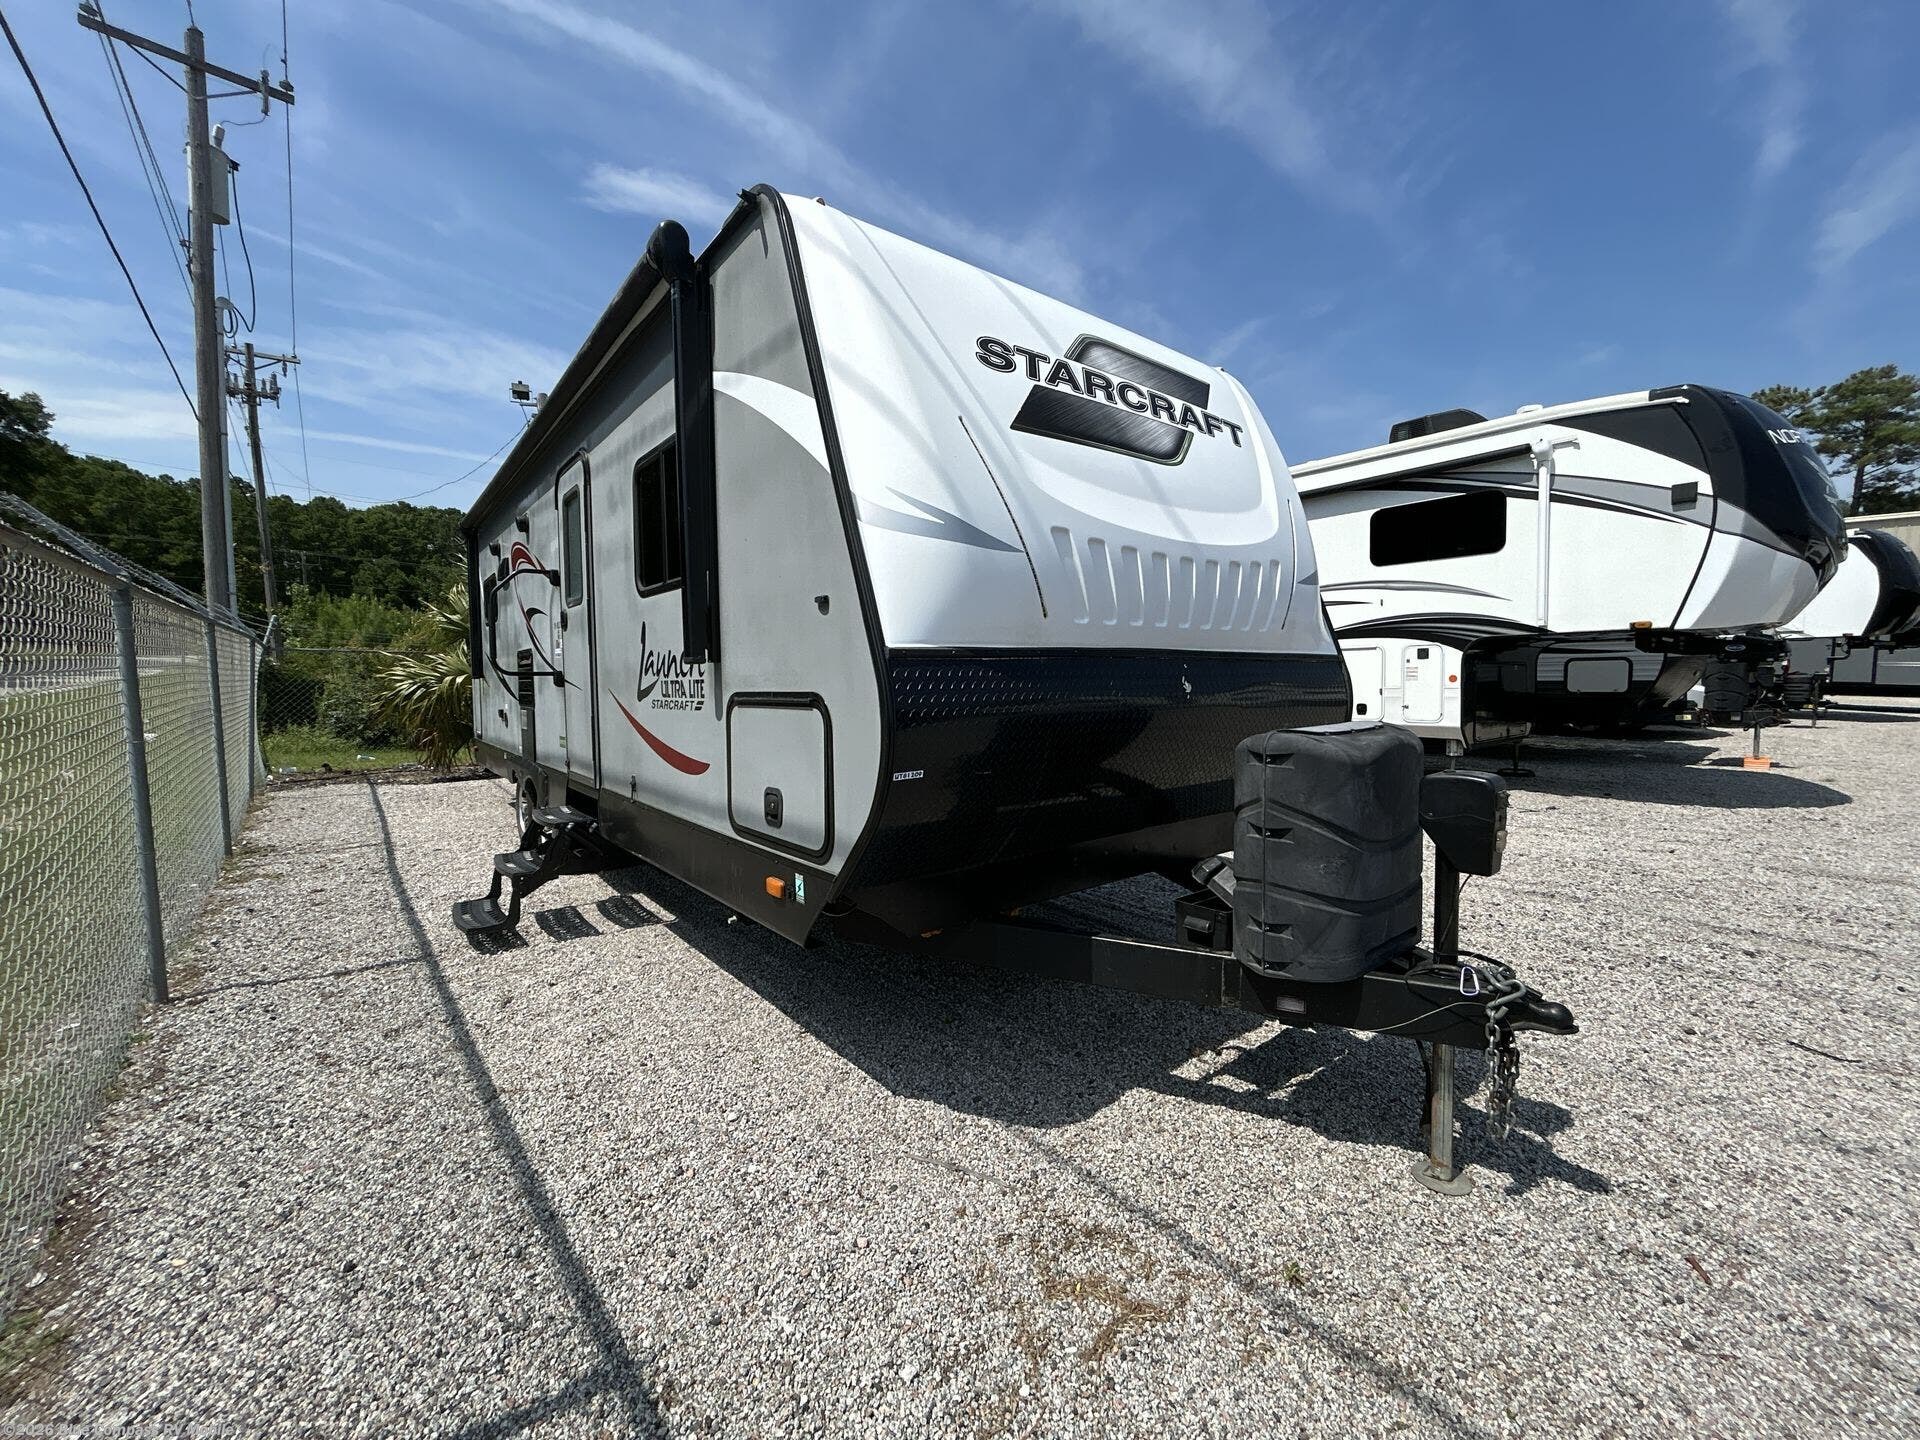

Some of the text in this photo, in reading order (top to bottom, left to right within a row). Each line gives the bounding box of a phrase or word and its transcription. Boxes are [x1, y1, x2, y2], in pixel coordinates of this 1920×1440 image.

[976, 335, 1243, 448] STARCRAFT
[661, 679, 705, 699] ULTRA LITE
[651, 699, 695, 711] STARCRAFT
